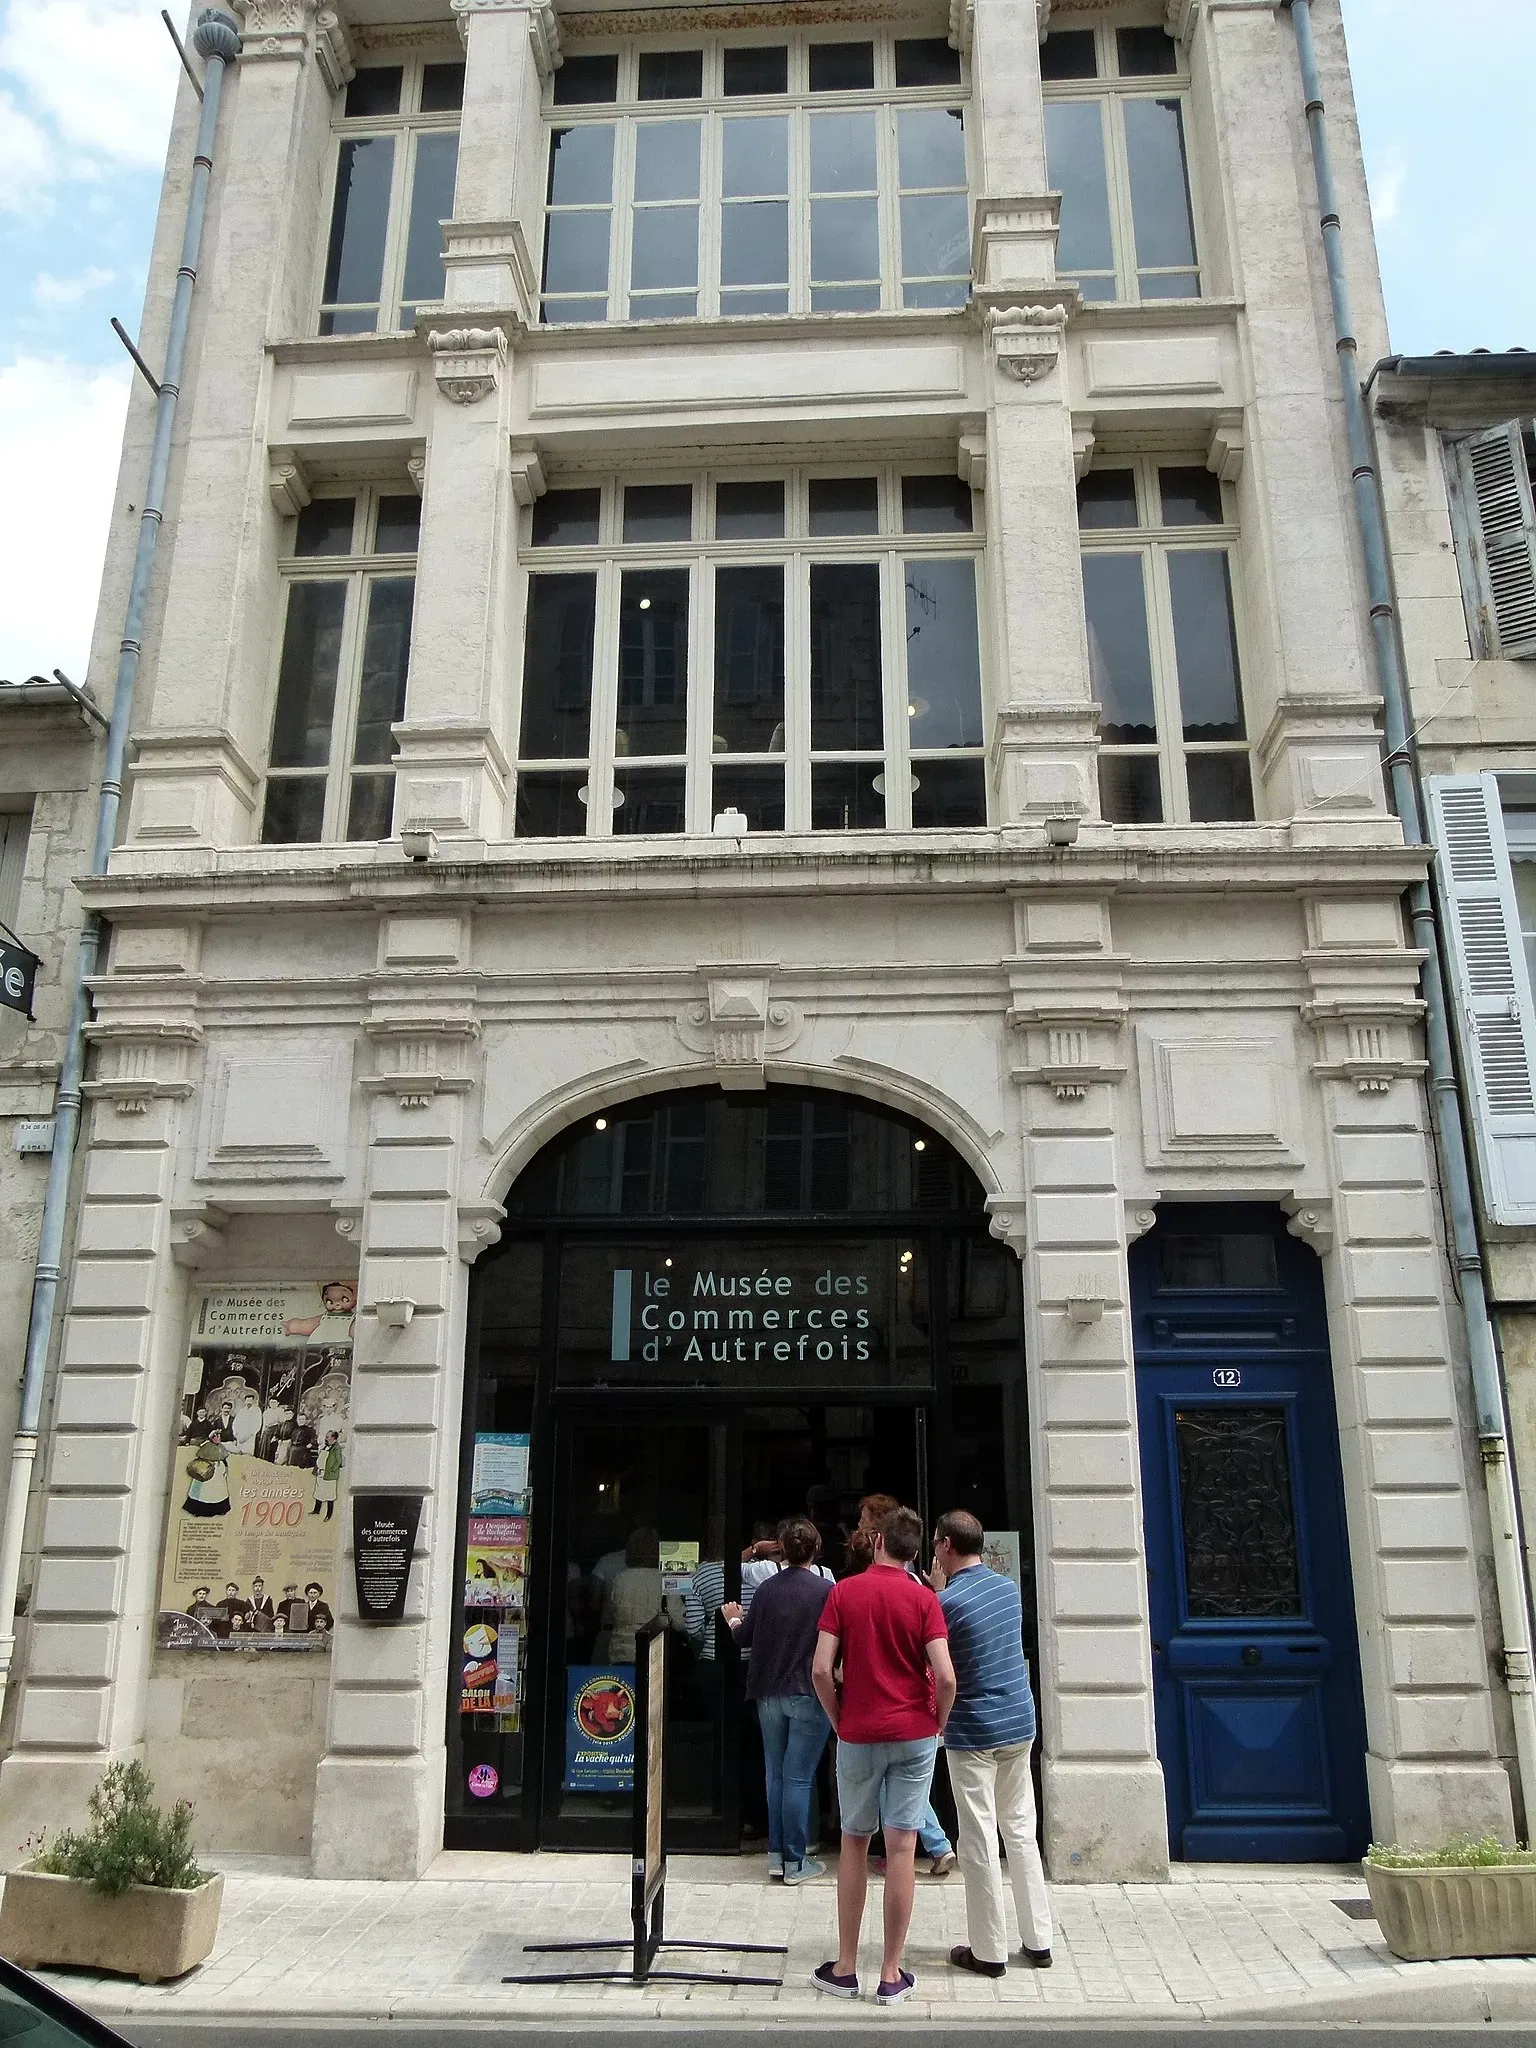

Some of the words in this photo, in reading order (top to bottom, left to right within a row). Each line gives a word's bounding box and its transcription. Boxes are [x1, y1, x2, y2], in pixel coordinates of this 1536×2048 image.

[644, 1271, 671, 1297] le
[692, 1268, 793, 1297] Musée
[814, 1269, 869, 1296] des
[212, 1298, 223, 1307] le
[226, 1296, 263, 1307] Musée
[266, 1298, 286, 1307] des
[210, 1310, 284, 1321] Commerces
[641, 1304, 870, 1330] Commerces
[208, 1324, 283, 1336] d'Autrefois
[1218, 1370, 1236, 1384] 12
[240, 1486, 257, 1498] les
[261, 1485, 305, 1498] années
[240, 1500, 304, 1528] 1900
[374, 1520, 394, 1528] Musée
[462, 1688, 490, 1698] SALON
[462, 1698, 476, 1710] DE
[478, 1696, 491, 1708] LA
[574, 1754, 584, 1763] La
[585, 1754, 610, 1763] vache
[610, 1754, 622, 1765] qui
[624, 1754, 634, 1763] rit
